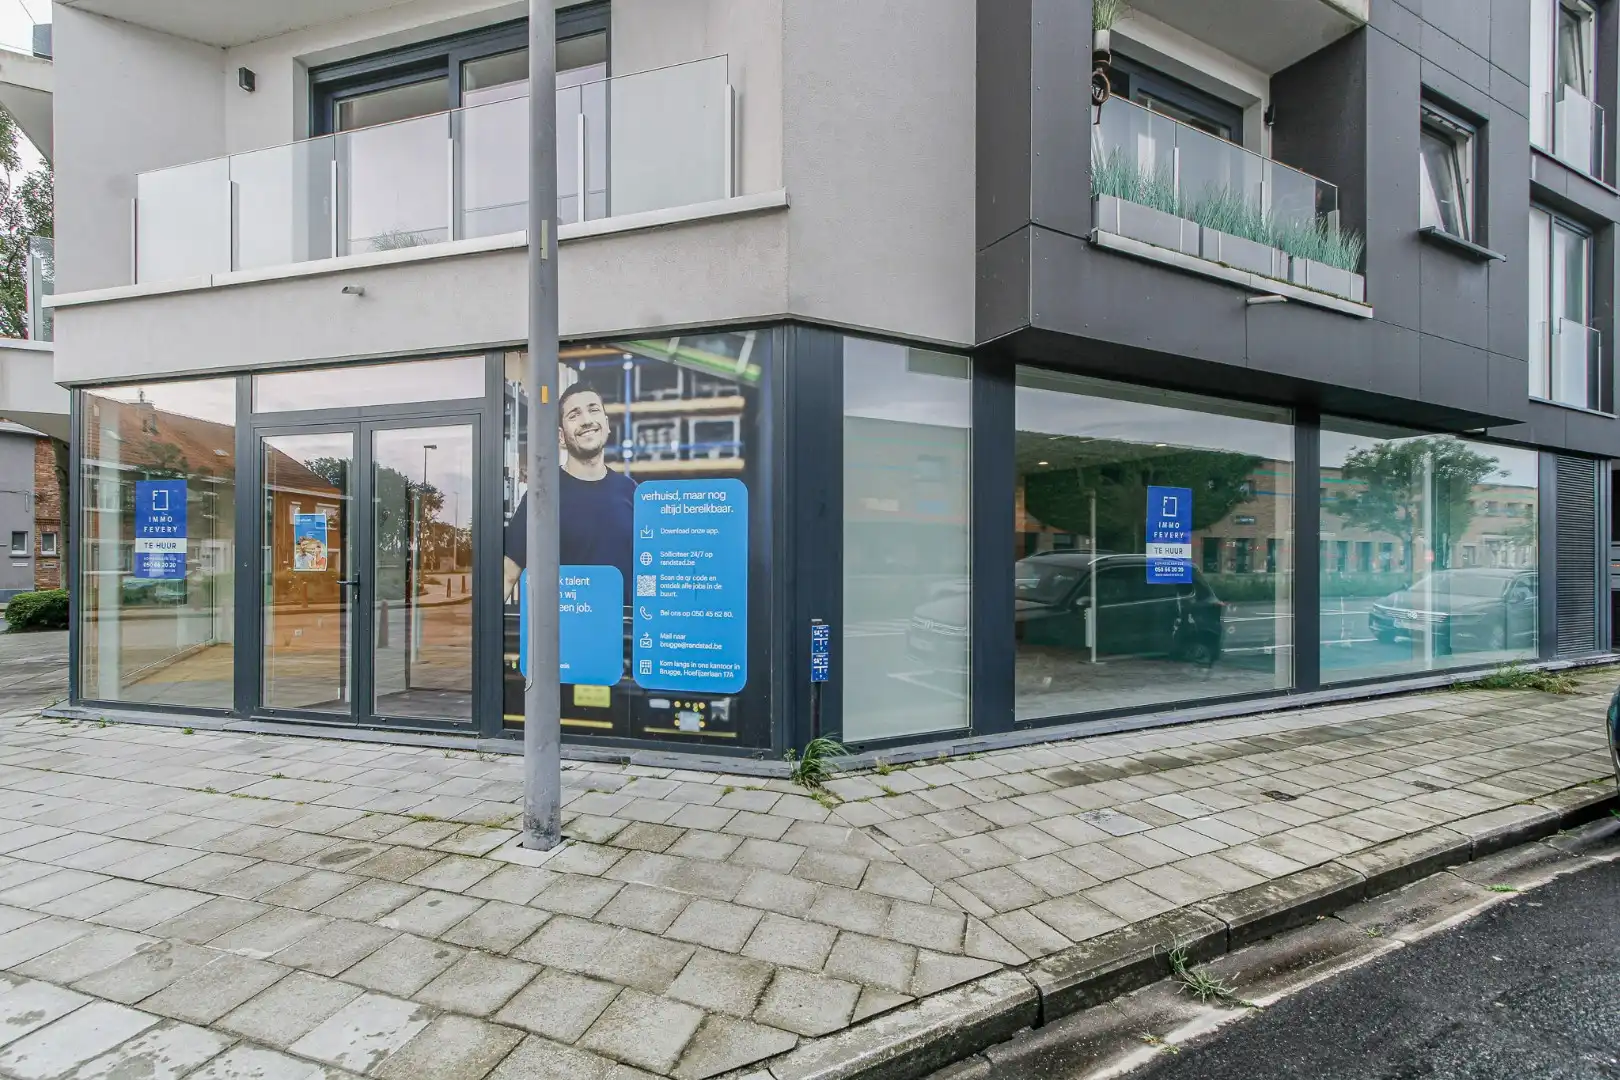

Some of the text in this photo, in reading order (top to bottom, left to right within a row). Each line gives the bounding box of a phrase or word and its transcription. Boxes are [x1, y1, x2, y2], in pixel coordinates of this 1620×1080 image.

[640, 490, 727, 502] verhuisd, maar nog
[660, 503, 734, 516] altijd bereikbaar.
[148, 515, 173, 523] IMMO
[1158, 521, 1180, 529] IMMO
[1153, 531, 1185, 539] FEVERY
[155, 542, 177, 550] HUUR
[690, 551, 704, 559] 24/7
[1164, 547, 1183, 555] HUUR
[565, 575, 590, 586] talent
[692, 582, 706, 590] jobs
[564, 588, 577, 601] wij
[575, 601, 593, 614] job.
[660, 632, 673, 640] Mail
[674, 660, 690, 669] langs
[709, 662, 733, 670] kantoor
